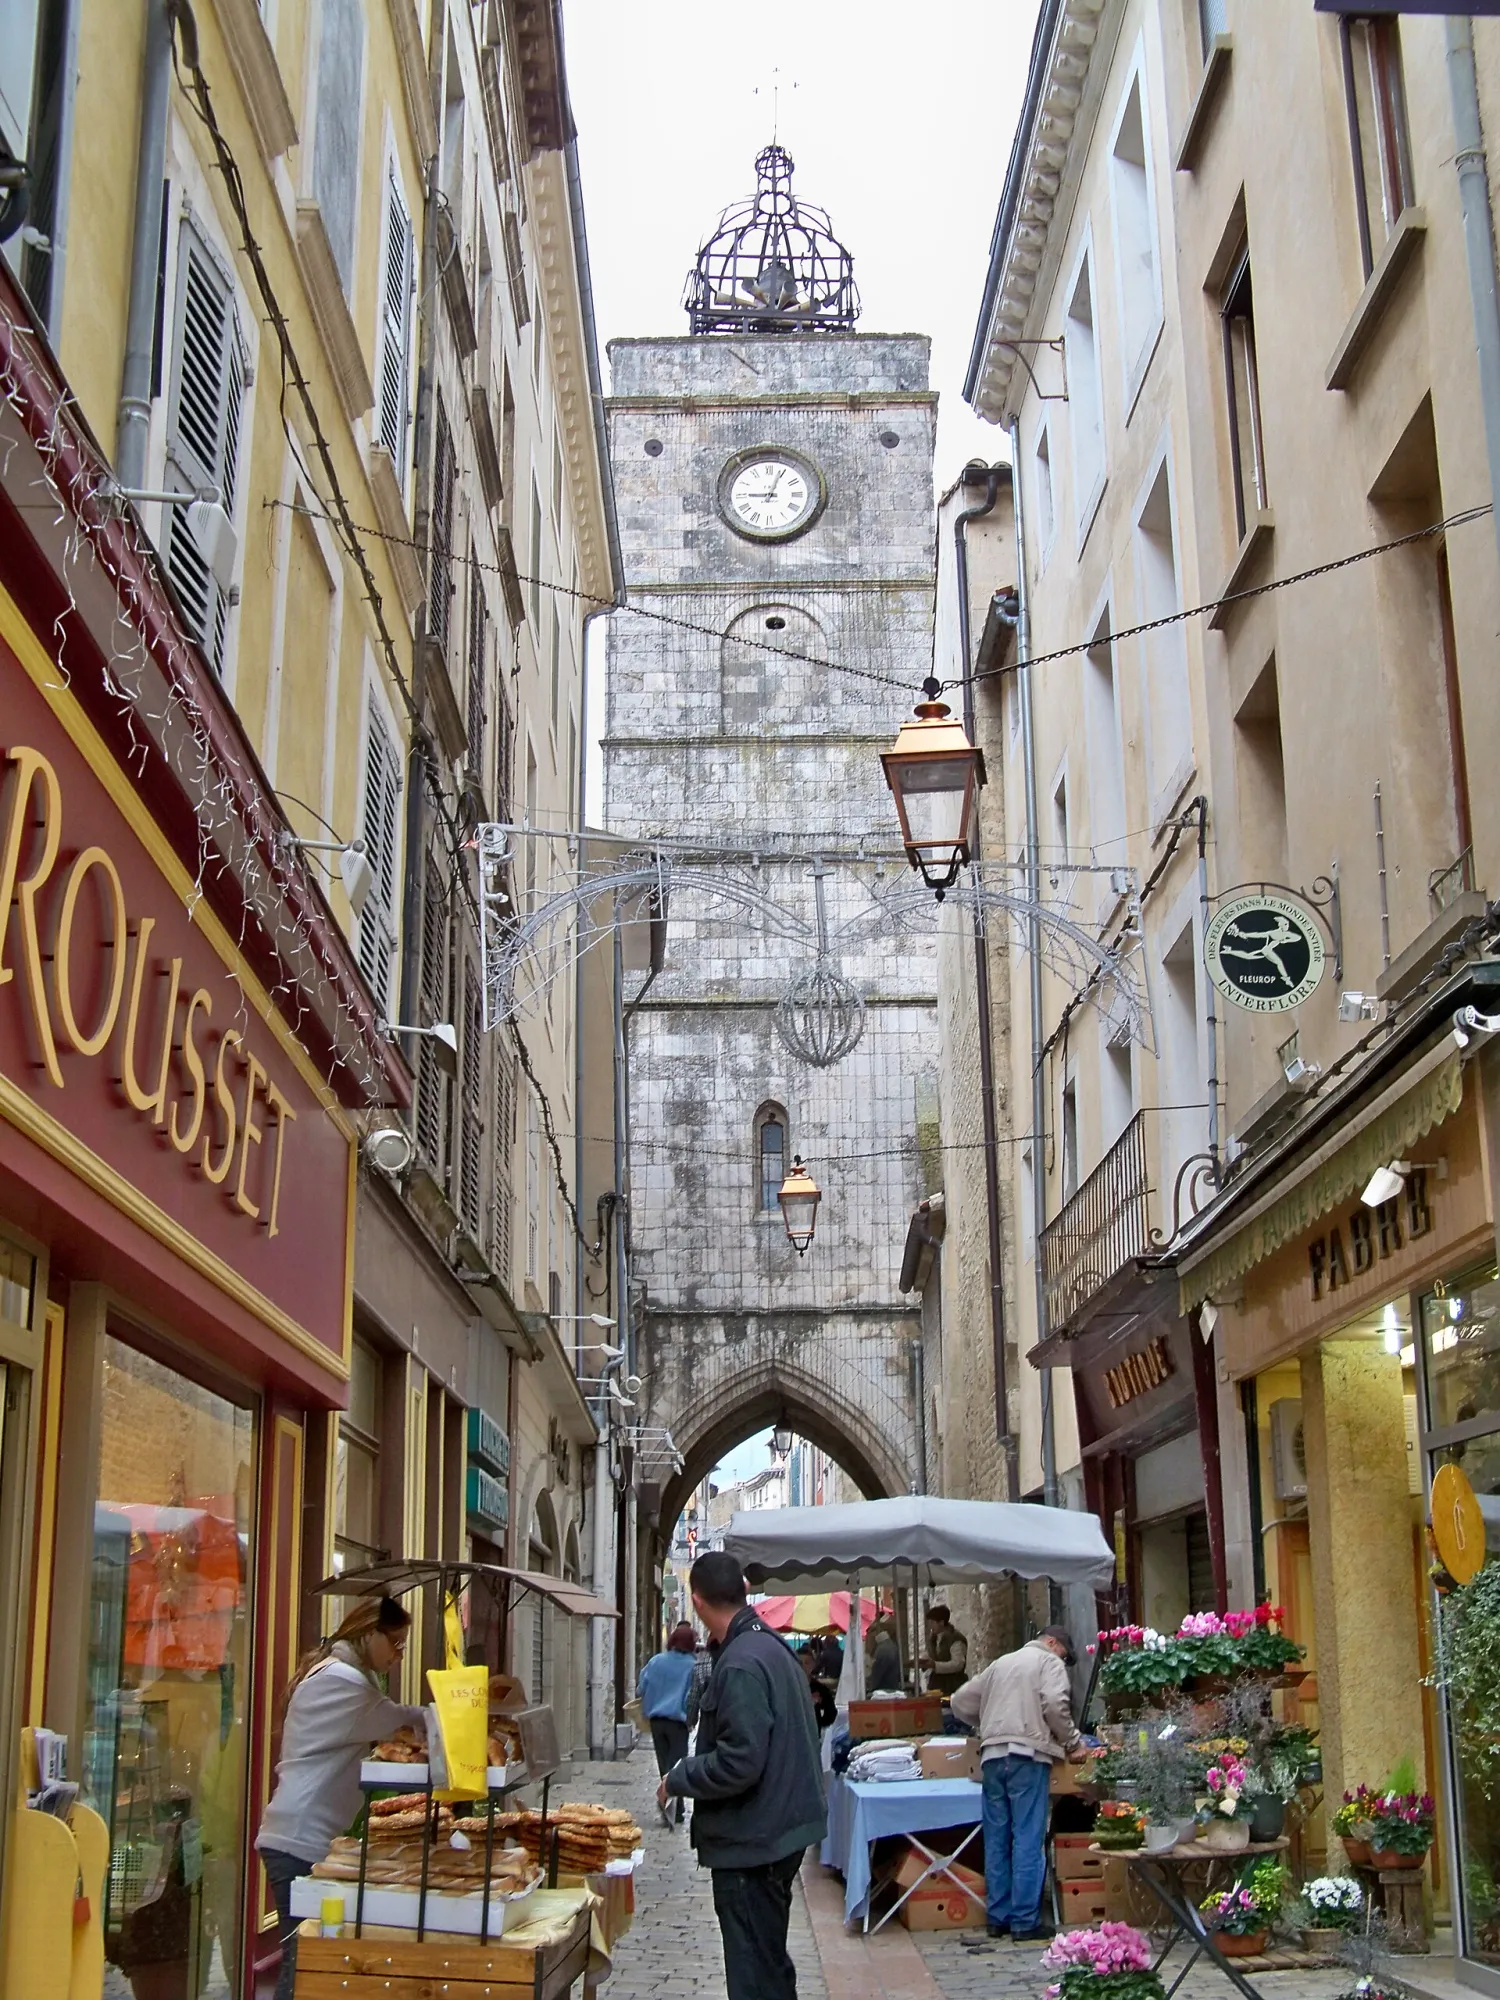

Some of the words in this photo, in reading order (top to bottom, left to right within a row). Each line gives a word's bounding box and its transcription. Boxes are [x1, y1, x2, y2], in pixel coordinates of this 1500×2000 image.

[1210, 908, 1236, 940] FLEURS
[1235, 898, 1262, 912] DANS
[1263, 898, 1277, 908] LE
[1277, 902, 1308, 928] MONDE
[1307, 926, 1321, 963] ENTIER
[0, 746, 297, 1239] ROUSSET
[1218, 979, 1317, 1011] INTERFLORA
[1239, 975, 1277, 984] FLEUROP
[1308, 1168, 1431, 1302] FABRE
